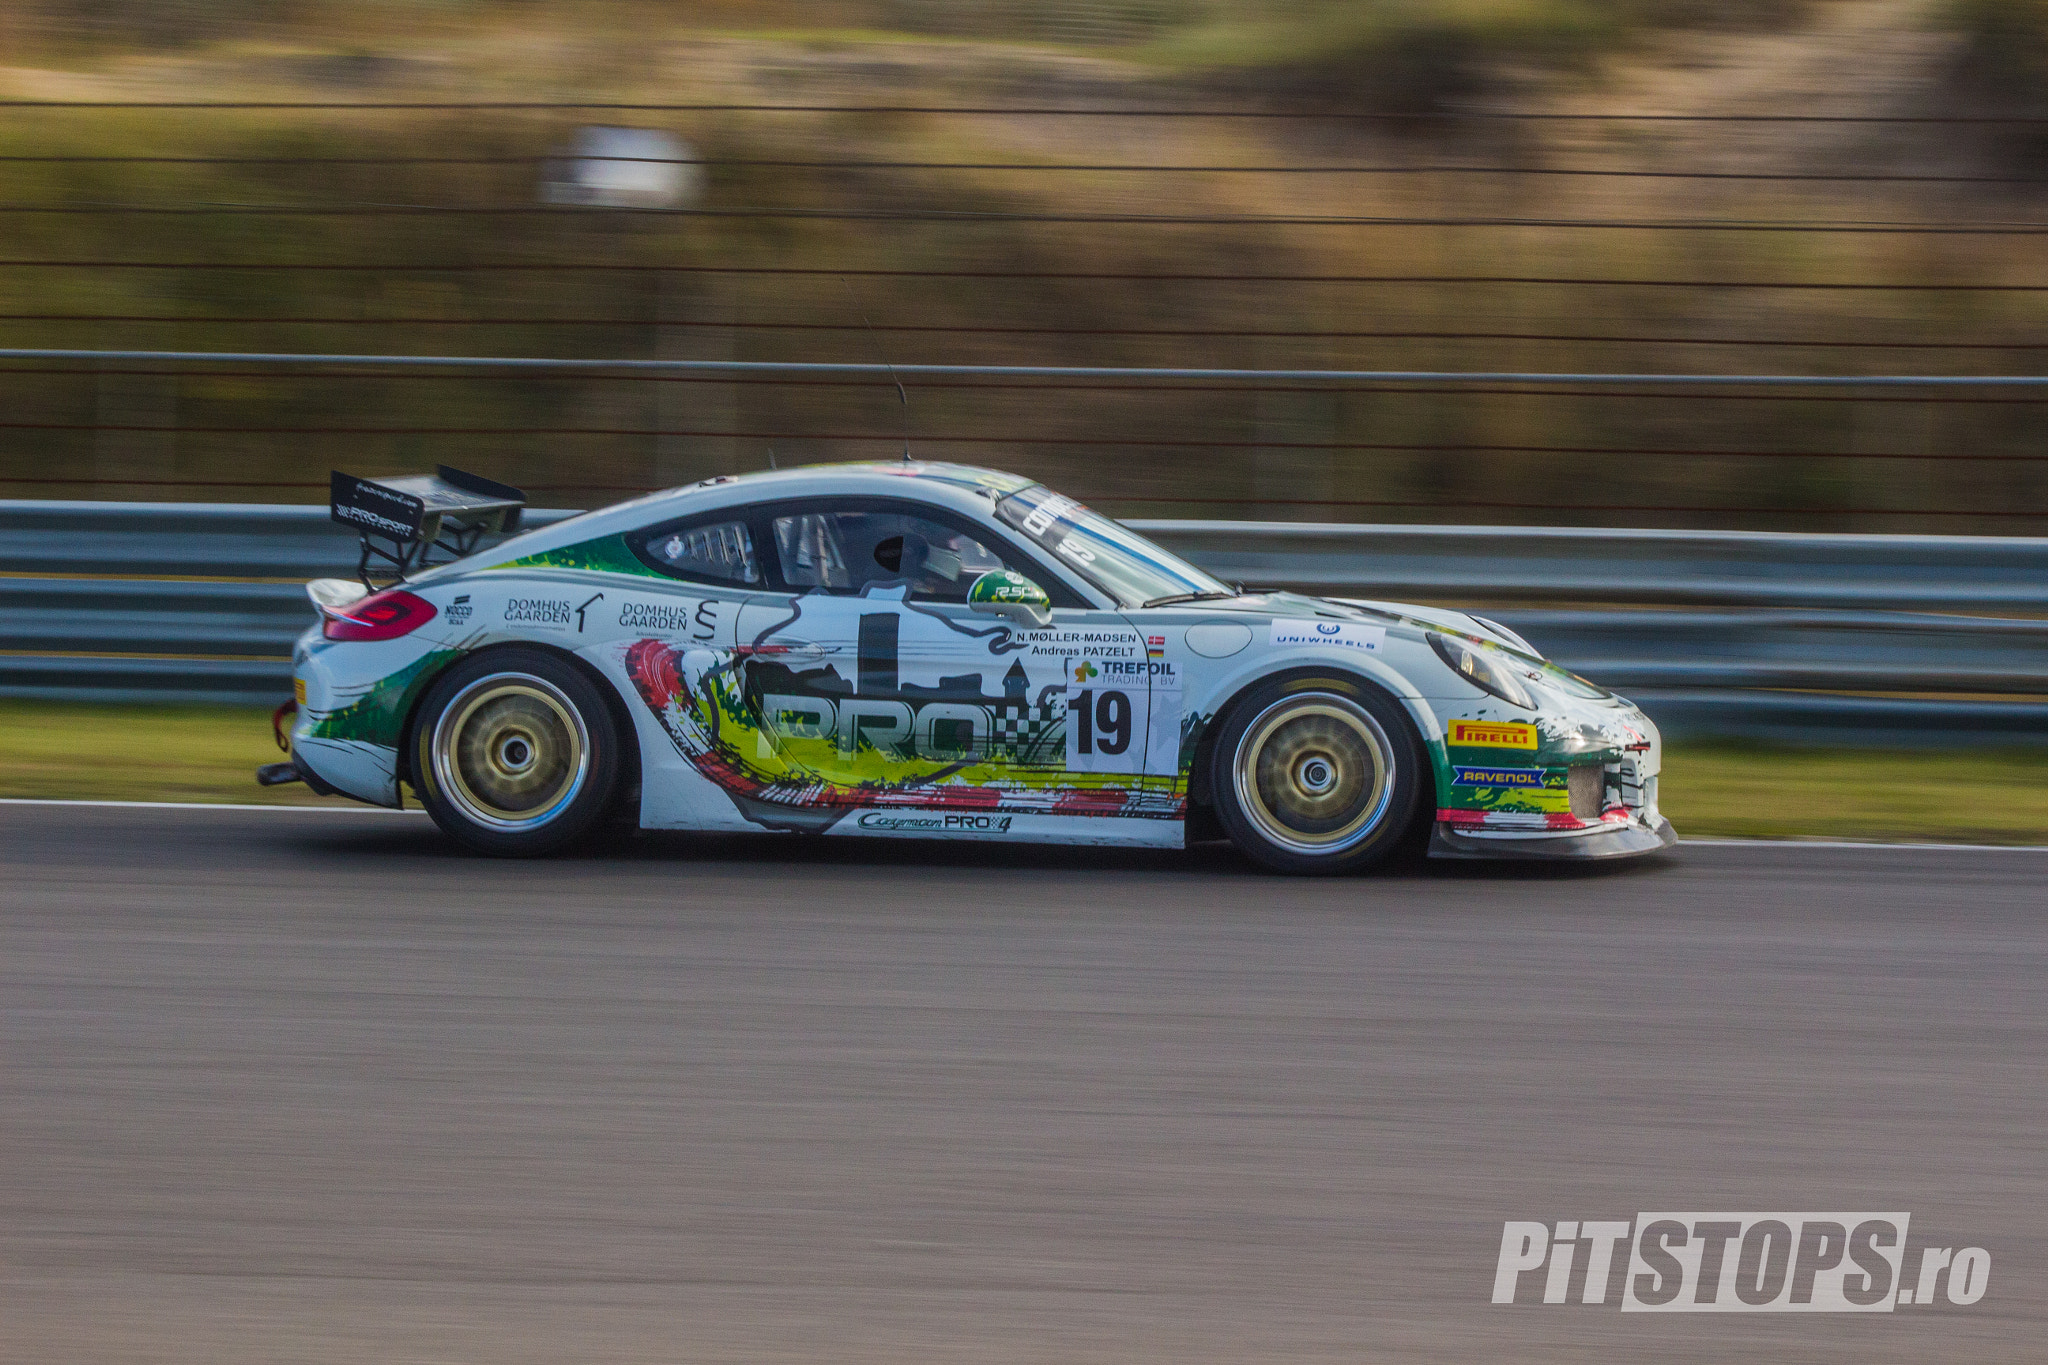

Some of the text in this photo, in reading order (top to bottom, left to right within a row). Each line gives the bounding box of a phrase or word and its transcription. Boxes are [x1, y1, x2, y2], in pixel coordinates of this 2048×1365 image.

[508, 598, 571, 612] DOMHUS
[622, 603, 688, 619] DOMHUS
[504, 610, 571, 624] GAARDEN
[619, 614, 688, 631] GAARDEN
[1016, 632, 1137, 644] N.MØLLER-MADSEN
[1277, 635, 1376, 649] UNIWHEELS
[1031, 645, 1136, 657] Andreas PATZELT
[1101, 661, 1176, 676] TREFOIL
[1102, 675, 1176, 686] TRADING BV
[1067, 688, 1132, 756] 19
[1456, 724, 1529, 745] PIRELLI
[1463, 771, 1538, 785] RAVENOL
[857, 812, 943, 829] Cayman
[944, 815, 990, 829] PRO
